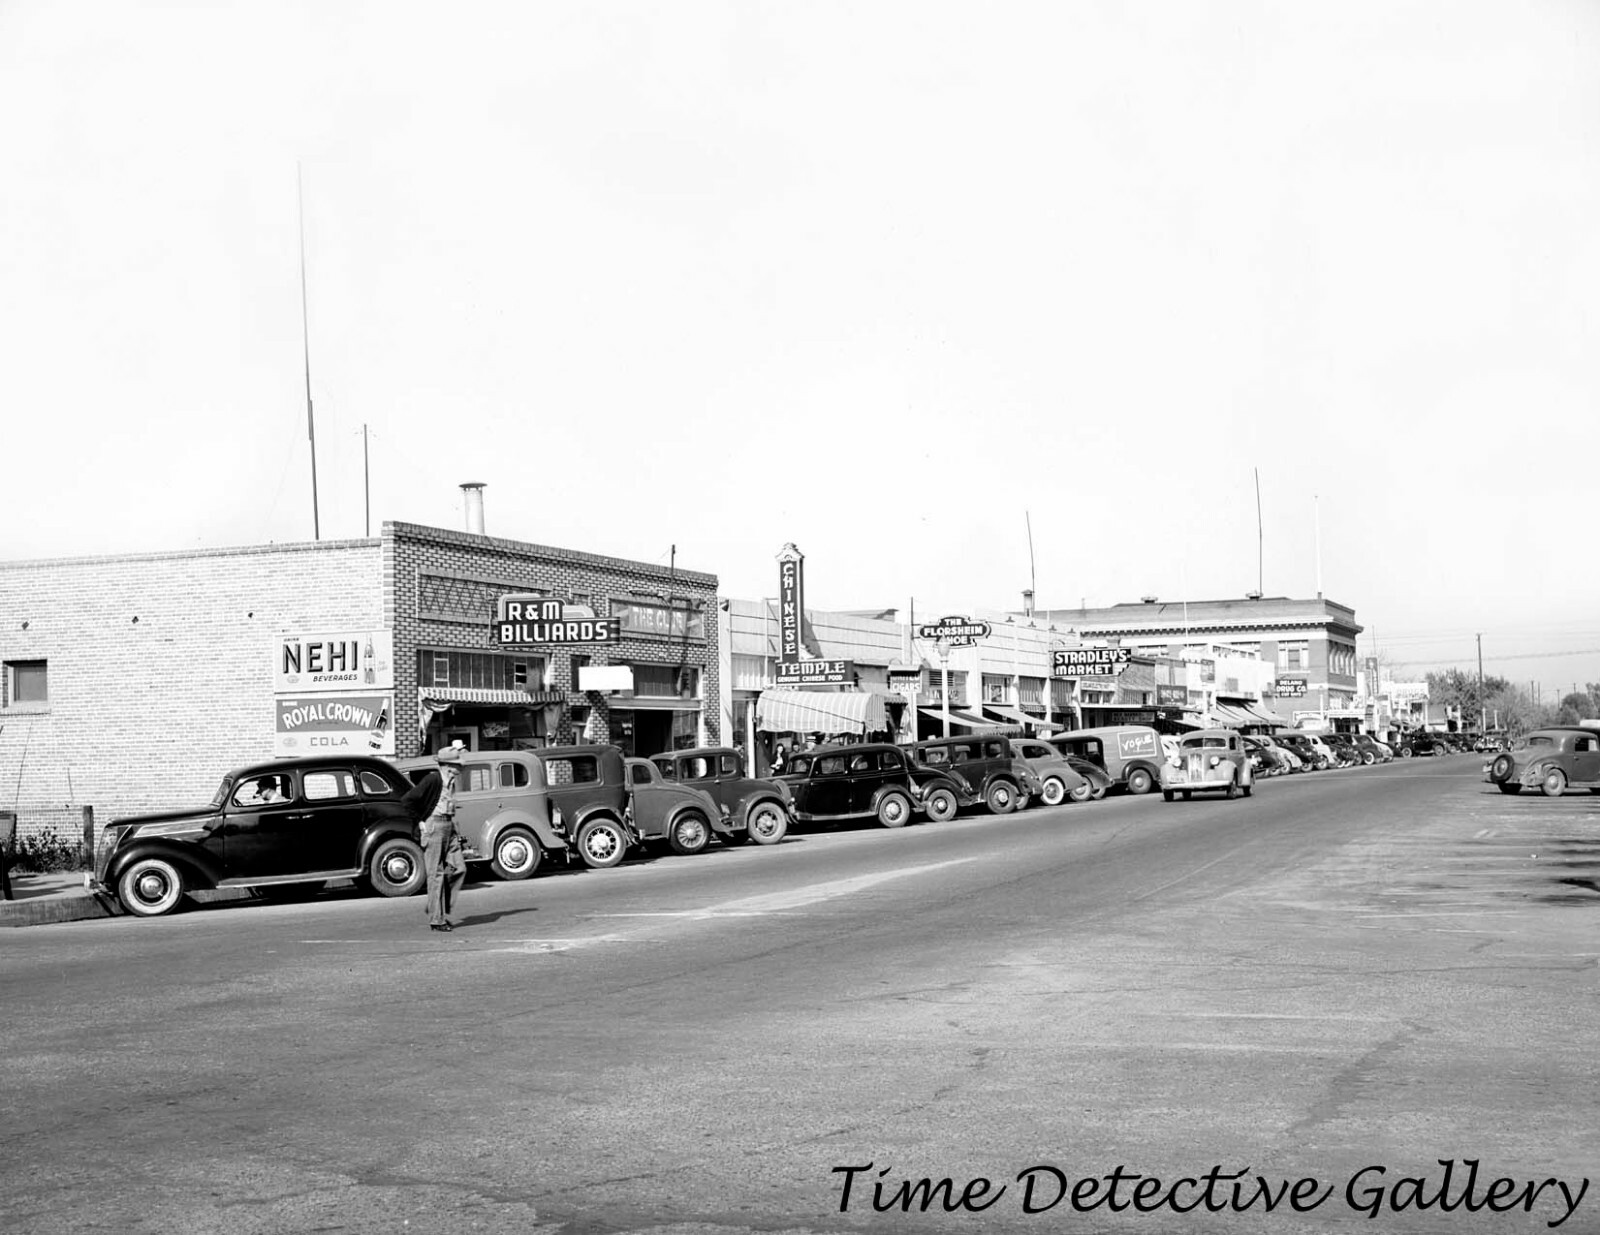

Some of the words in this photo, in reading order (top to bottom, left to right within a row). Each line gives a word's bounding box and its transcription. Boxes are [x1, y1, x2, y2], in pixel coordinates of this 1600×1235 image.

[508, 600, 560, 621] R&M
[782, 562, 797, 655] CHINESE
[632, 606, 655, 627] THE
[944, 618, 963, 626] THE
[501, 622, 608, 643] BILLIARDS
[940, 636, 968, 645] HOE
[282, 641, 358, 674] NEHI
[1055, 650, 1127, 663] STRADLEY'S
[777, 660, 846, 676] TEMPLE
[1055, 664, 1111, 675] MARKET
[313, 673, 358, 683] BEVERAGES
[892, 682, 920, 693] CIGARS
[1276, 685, 1295, 693] DRUG
[282, 703, 326, 730] ROYAL
[326, 702, 373, 729] CROWN
[310, 736, 349, 747] COLA
